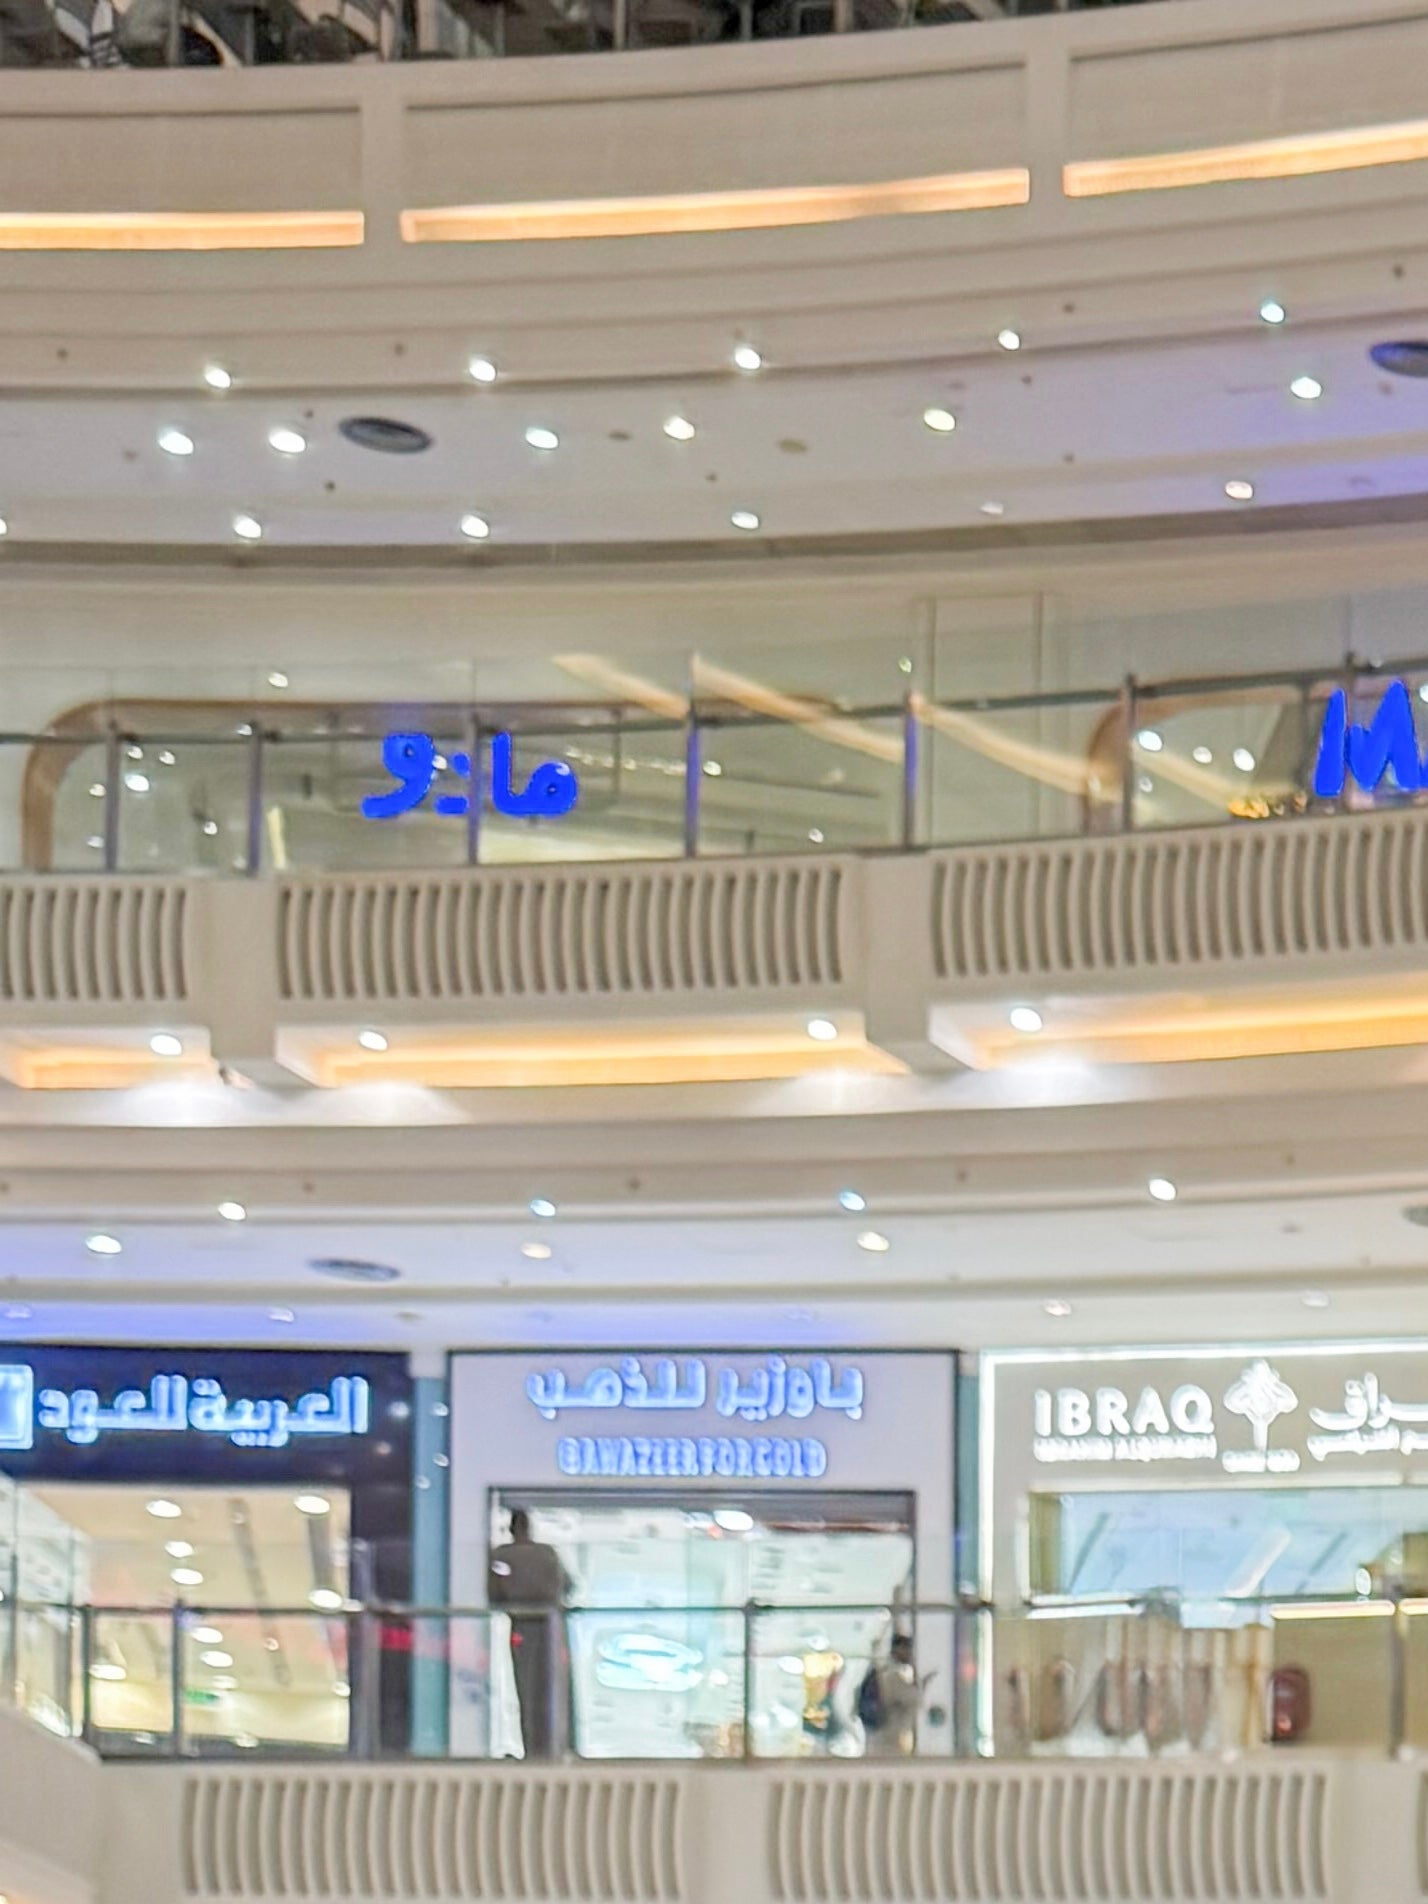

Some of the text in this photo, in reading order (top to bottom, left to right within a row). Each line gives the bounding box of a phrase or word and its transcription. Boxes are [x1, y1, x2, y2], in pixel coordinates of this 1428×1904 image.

[38, 1374, 369, 1448] العربية للعود
[526, 1354, 863, 1420] باوزير للذهب
[1034, 1383, 1215, 1436] IBRAQ
